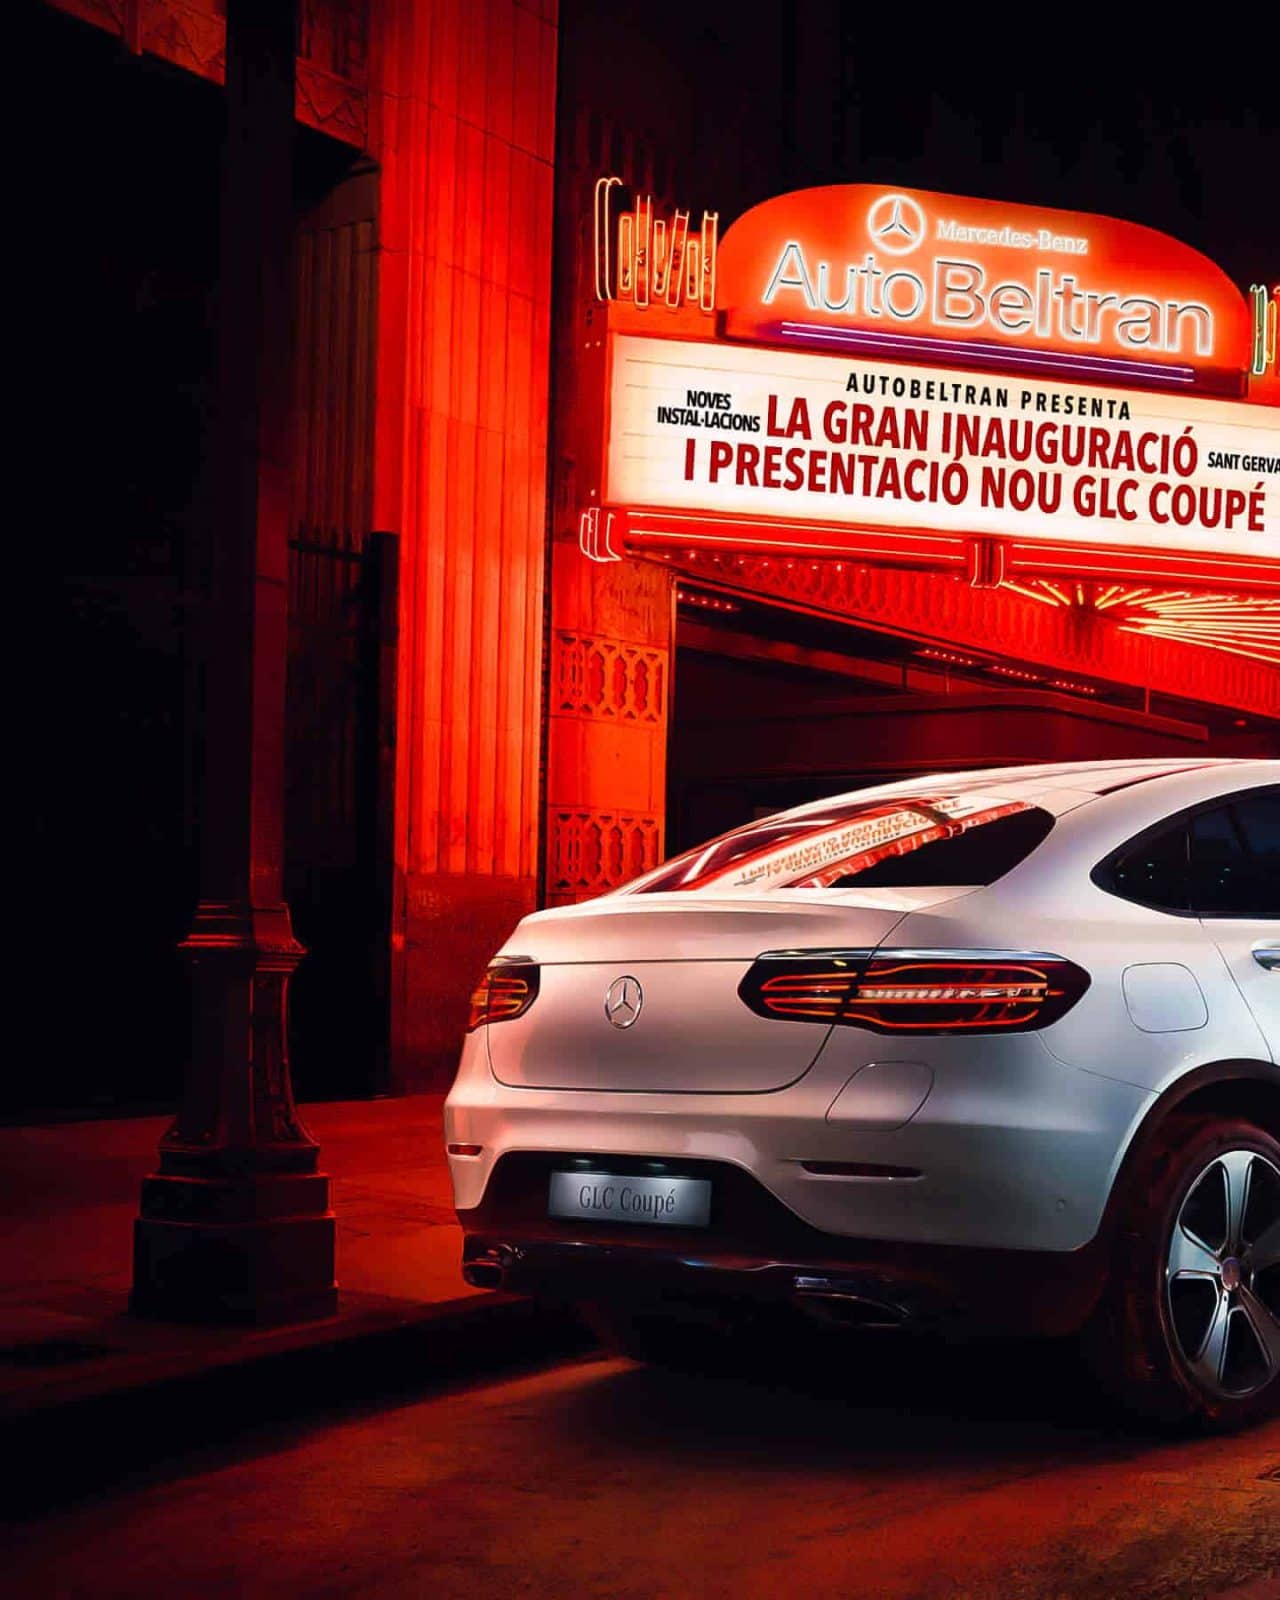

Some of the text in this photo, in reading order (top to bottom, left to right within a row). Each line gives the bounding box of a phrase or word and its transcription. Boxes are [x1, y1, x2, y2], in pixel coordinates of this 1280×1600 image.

[936, 219, 1089, 255] Mercedes-Benz
[686, 390, 731, 410] NOVES
[846, 373, 1130, 420] AUTOBELTRAN PRESENTA
[767, 395, 1198, 477] LA GRAN INAUGURACIÓ
[1207, 451, 1241, 470] SANT
[684, 438, 1265, 532] I PRESENTACIÓ NOU GLC COUPÉ
[579, 1185, 676, 1219] GLC Coupé
